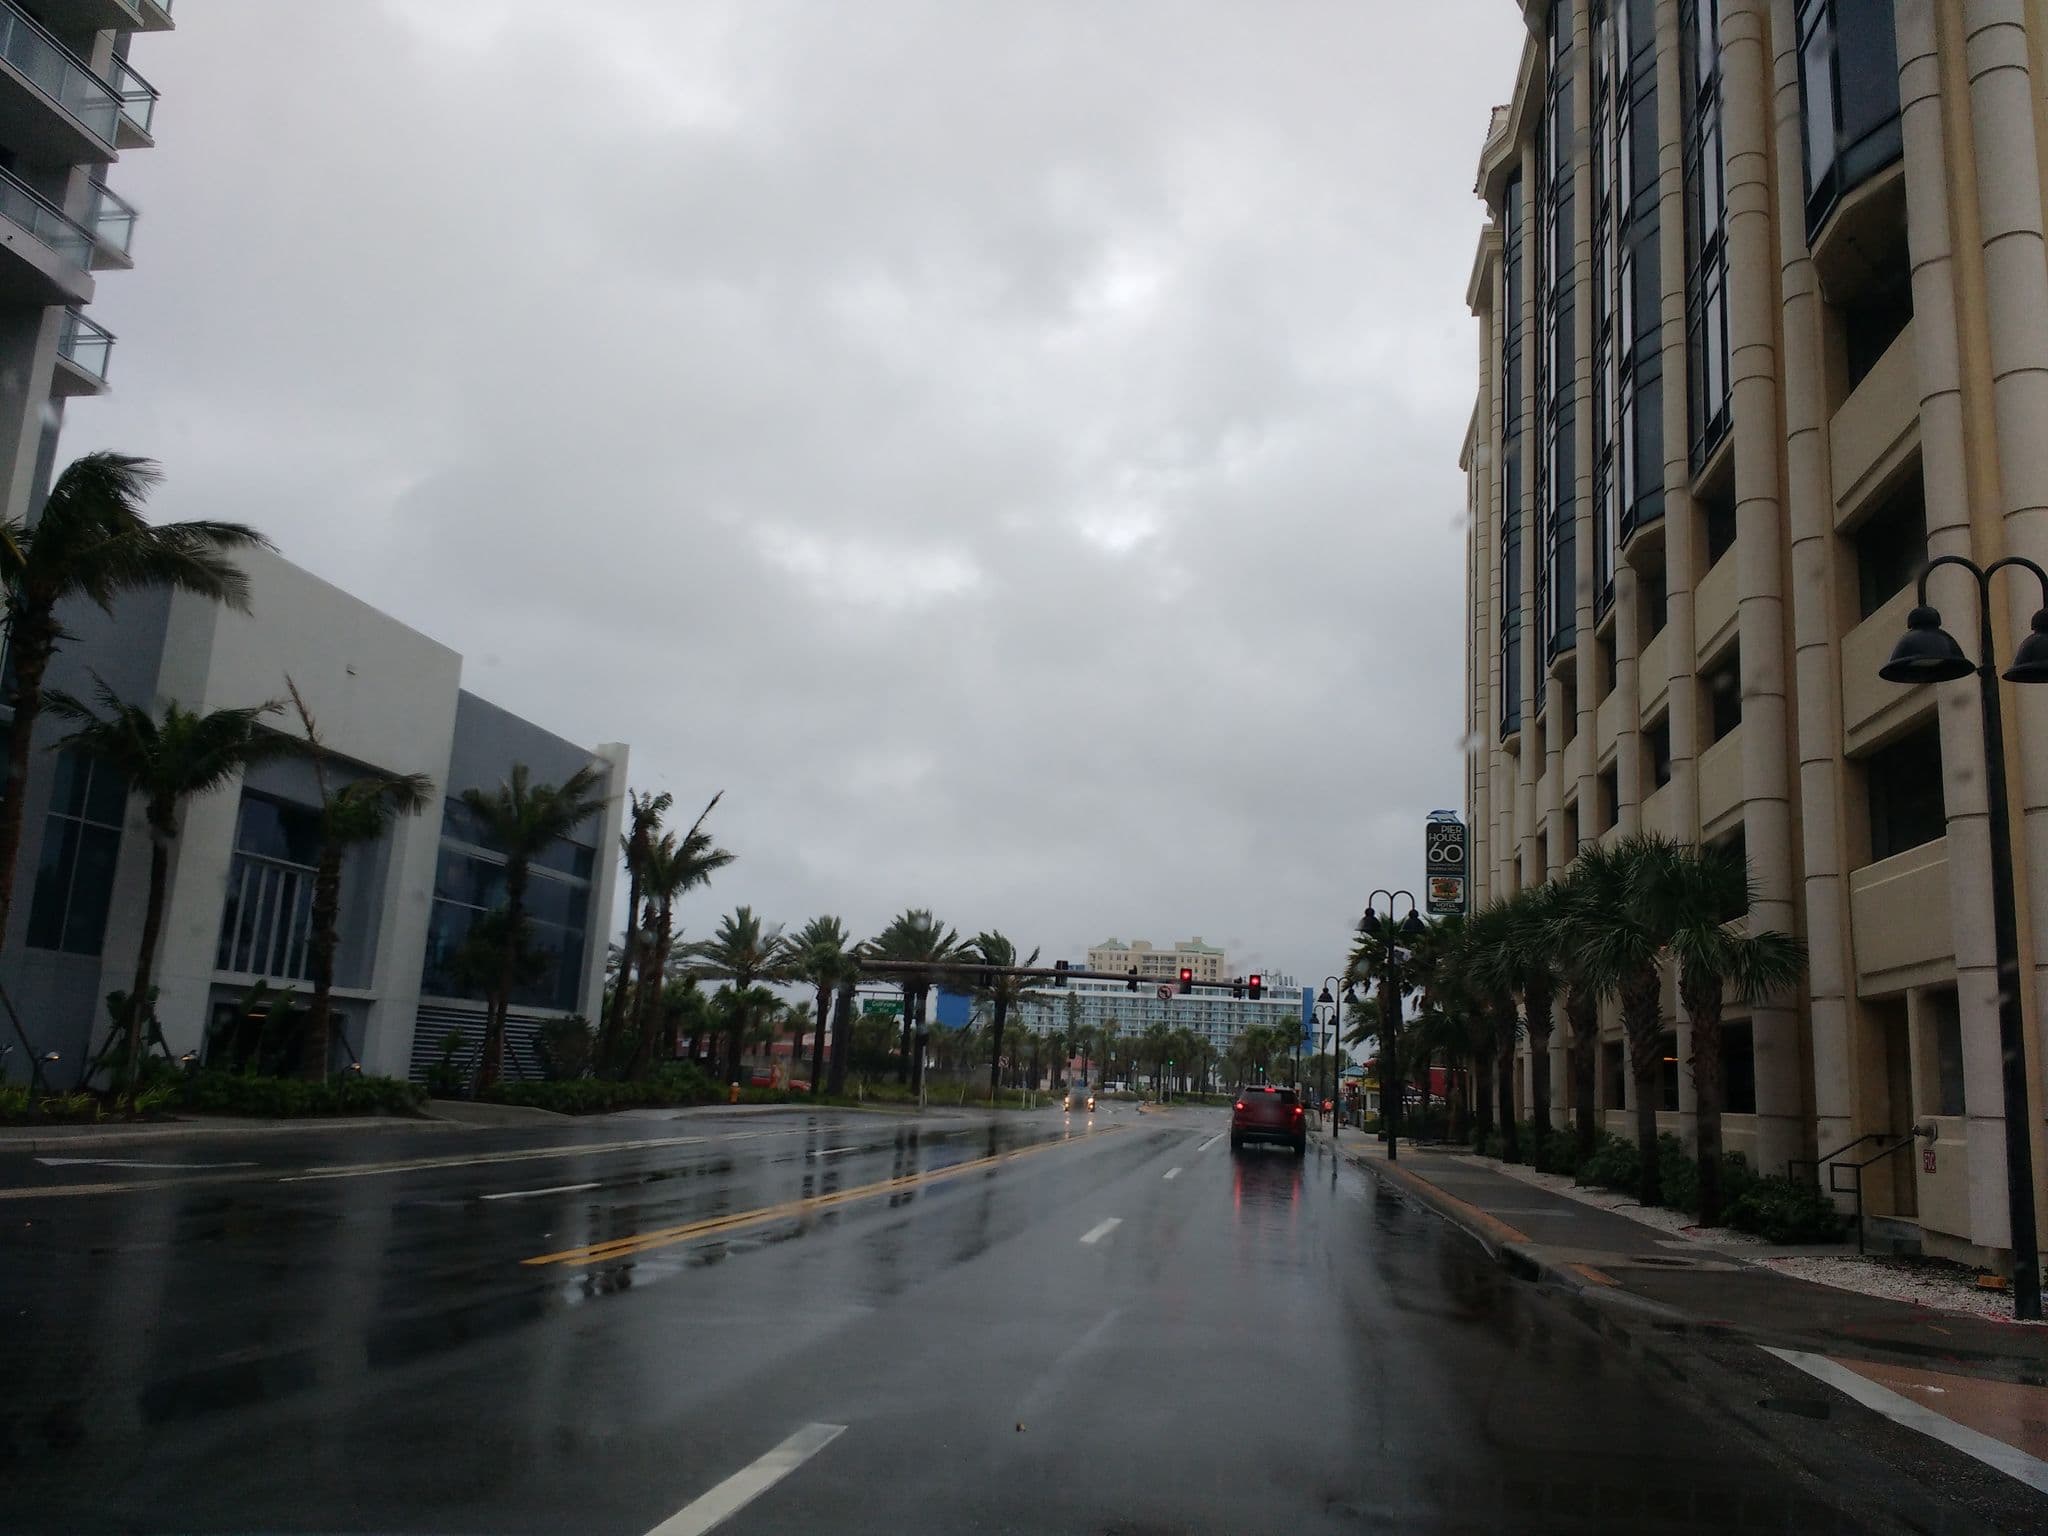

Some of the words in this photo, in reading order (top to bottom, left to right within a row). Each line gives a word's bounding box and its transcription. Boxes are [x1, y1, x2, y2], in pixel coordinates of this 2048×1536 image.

[1441, 825, 1462, 833] PIER
[1429, 833, 1464, 841] HOUSE
[1429, 842, 1463, 862] 60
